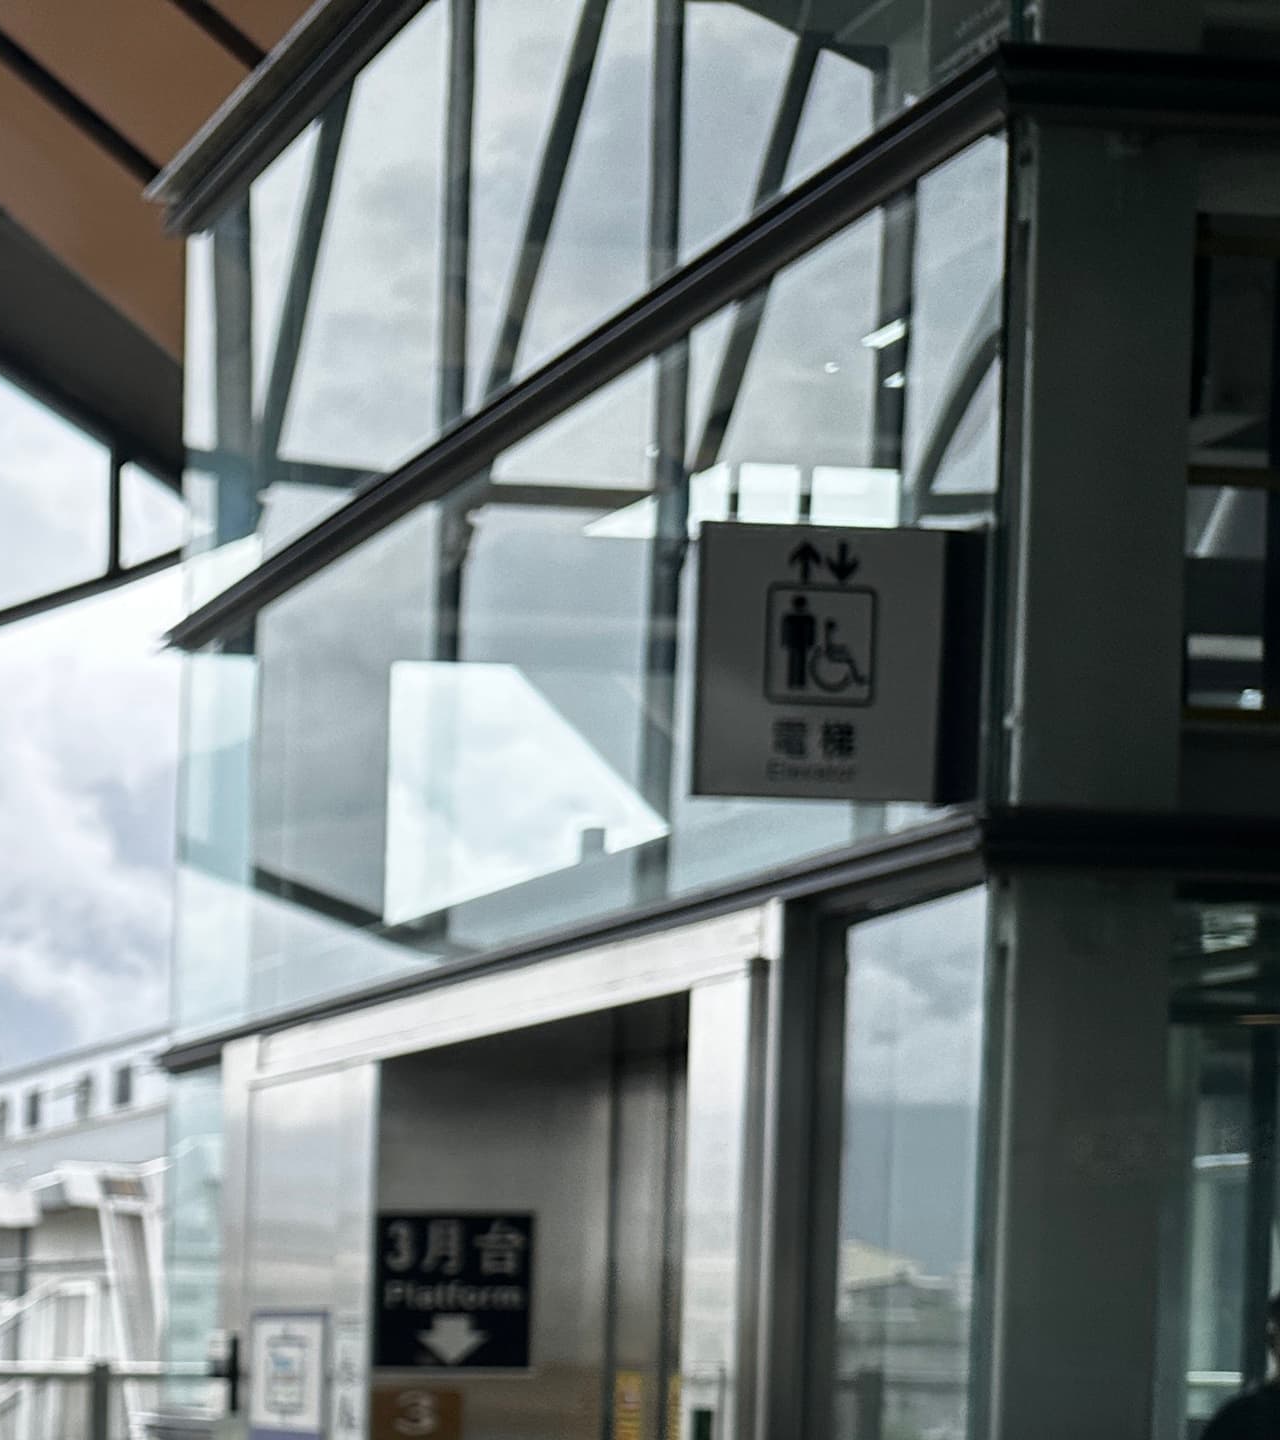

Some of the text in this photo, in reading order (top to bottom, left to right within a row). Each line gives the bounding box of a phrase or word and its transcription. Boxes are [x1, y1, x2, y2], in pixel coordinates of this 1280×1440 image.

[772, 719, 854, 760] 電梯
[386, 1219, 527, 1273] 3月台
[385, 1279, 522, 1310] Platform
[395, 1391, 437, 1436] 3
